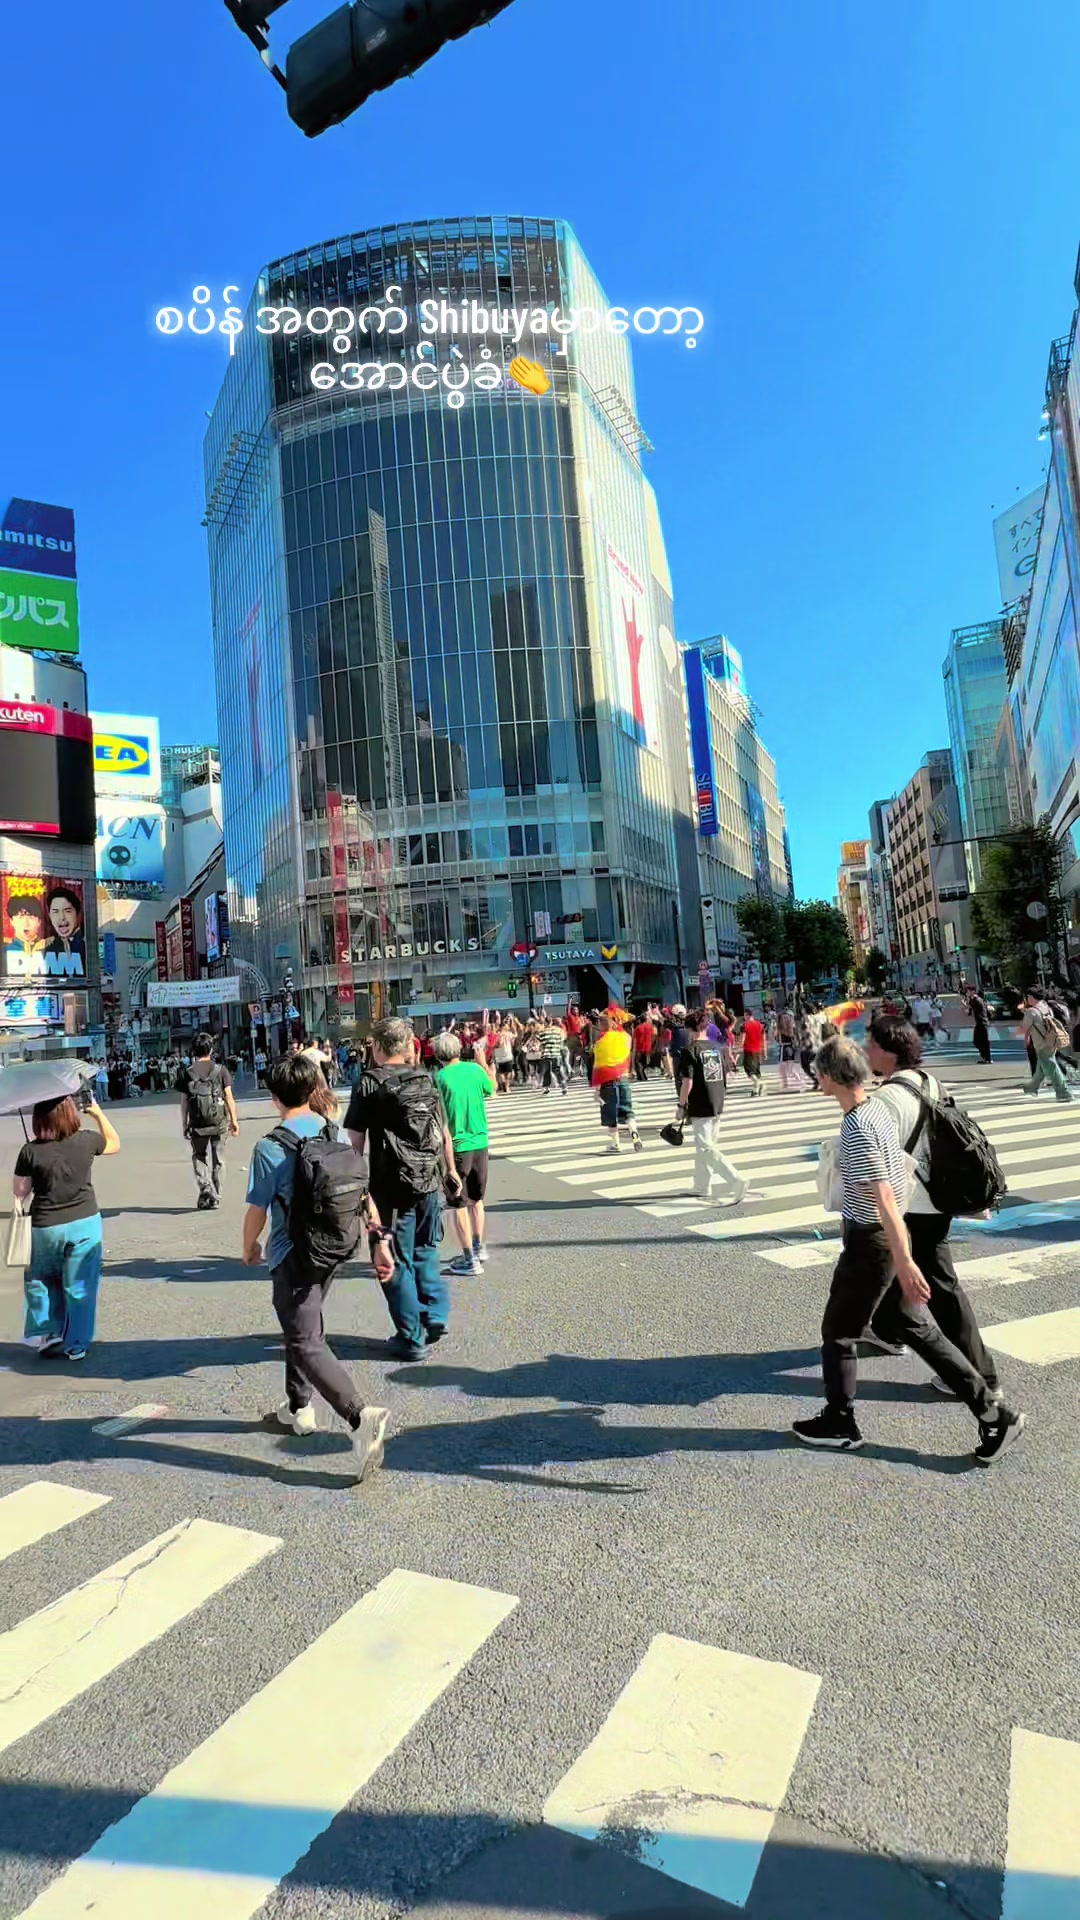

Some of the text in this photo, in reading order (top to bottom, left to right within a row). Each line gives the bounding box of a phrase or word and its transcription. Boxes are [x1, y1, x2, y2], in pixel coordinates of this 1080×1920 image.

[0, 529, 73, 552] mitsu
[6, 950, 84, 975] DMM
[340, 937, 480, 965] STARBUCKS
[545, 949, 595, 960] TSUTAYA
